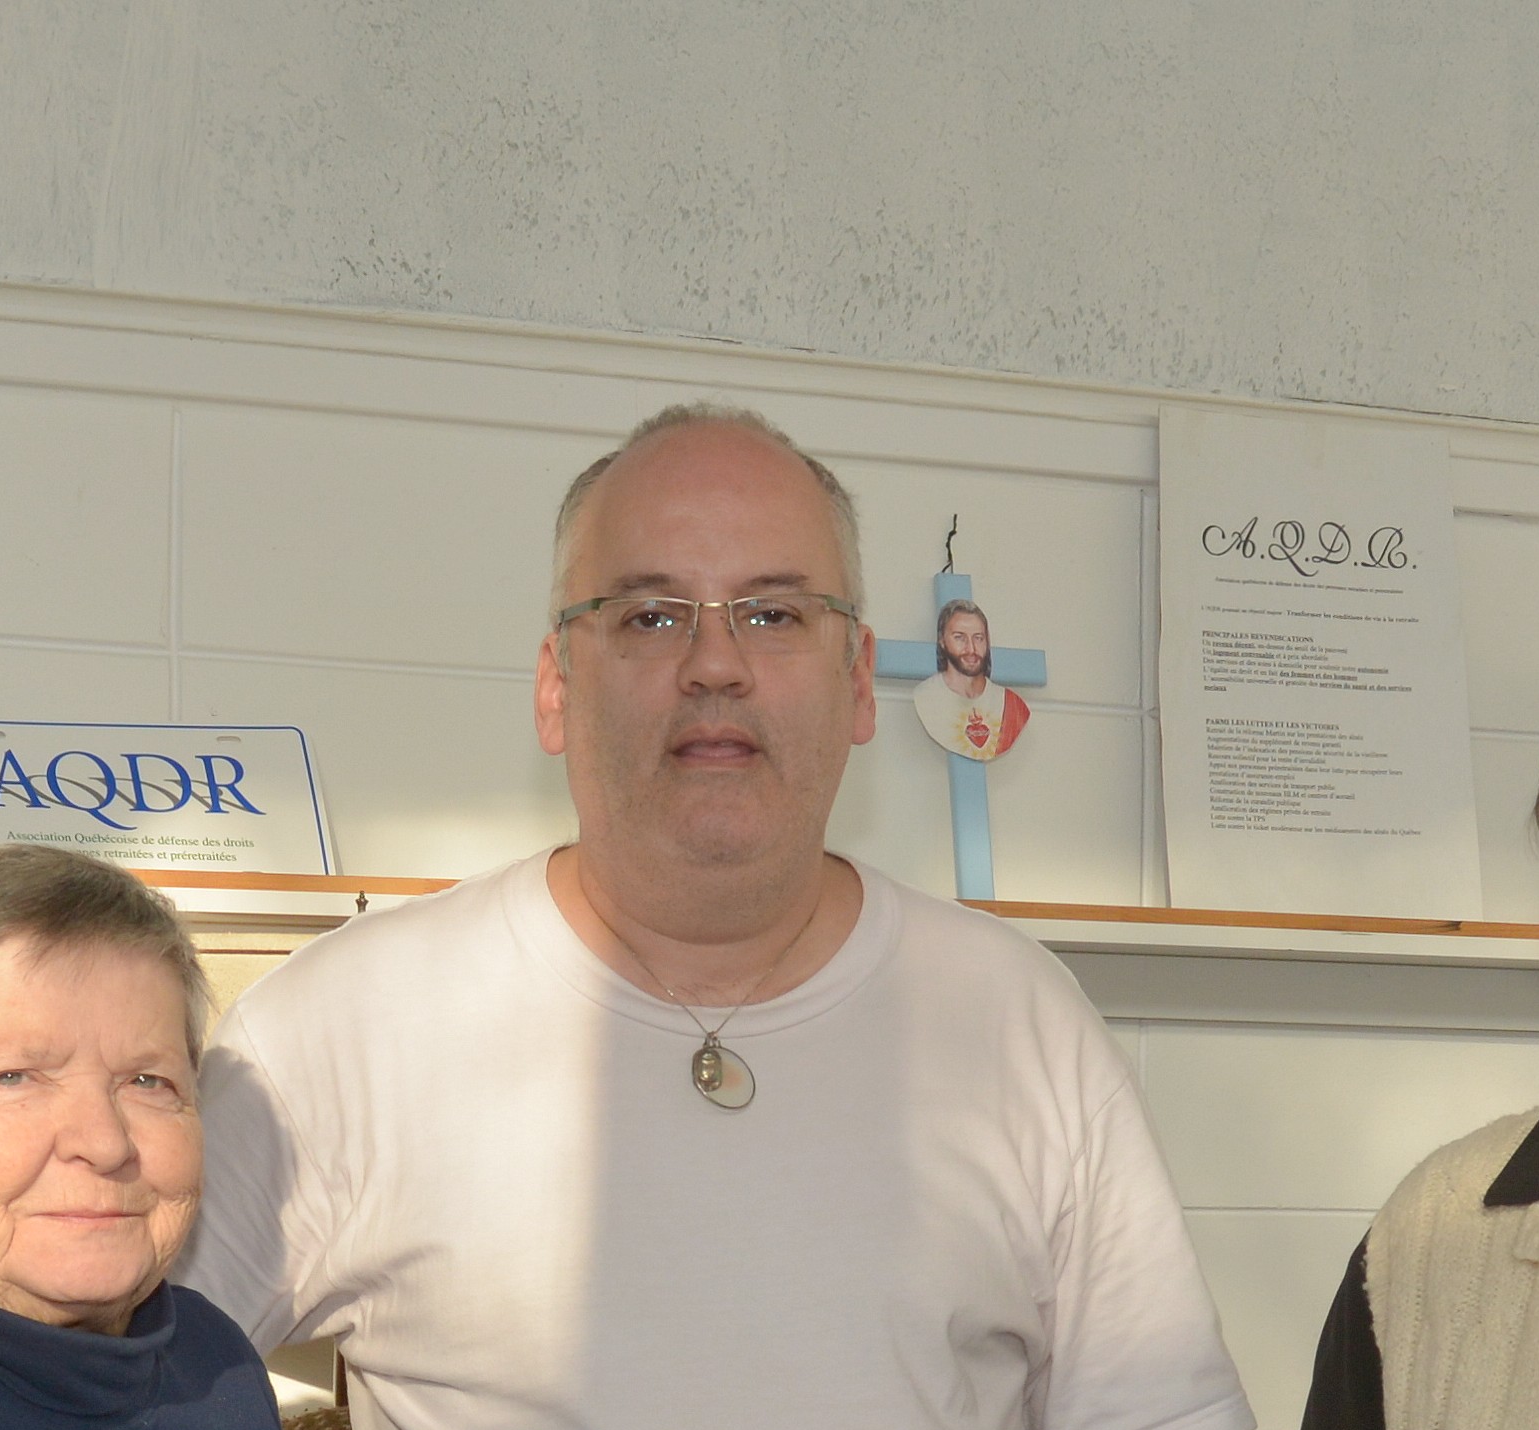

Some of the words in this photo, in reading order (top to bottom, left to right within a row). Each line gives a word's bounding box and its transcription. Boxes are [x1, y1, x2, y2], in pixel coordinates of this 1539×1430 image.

[6, 831, 72, 843] Association
[74, 832, 139, 845] Québécoise
[141, 834, 155, 846] de
[157, 835, 199, 847] défense
[202, 836, 221, 848] des
[223, 837, 255, 849] droits
[104, 848, 154, 860] retraitées
[156, 850, 167, 860] et
[170, 851, 237, 863] préretraitées
